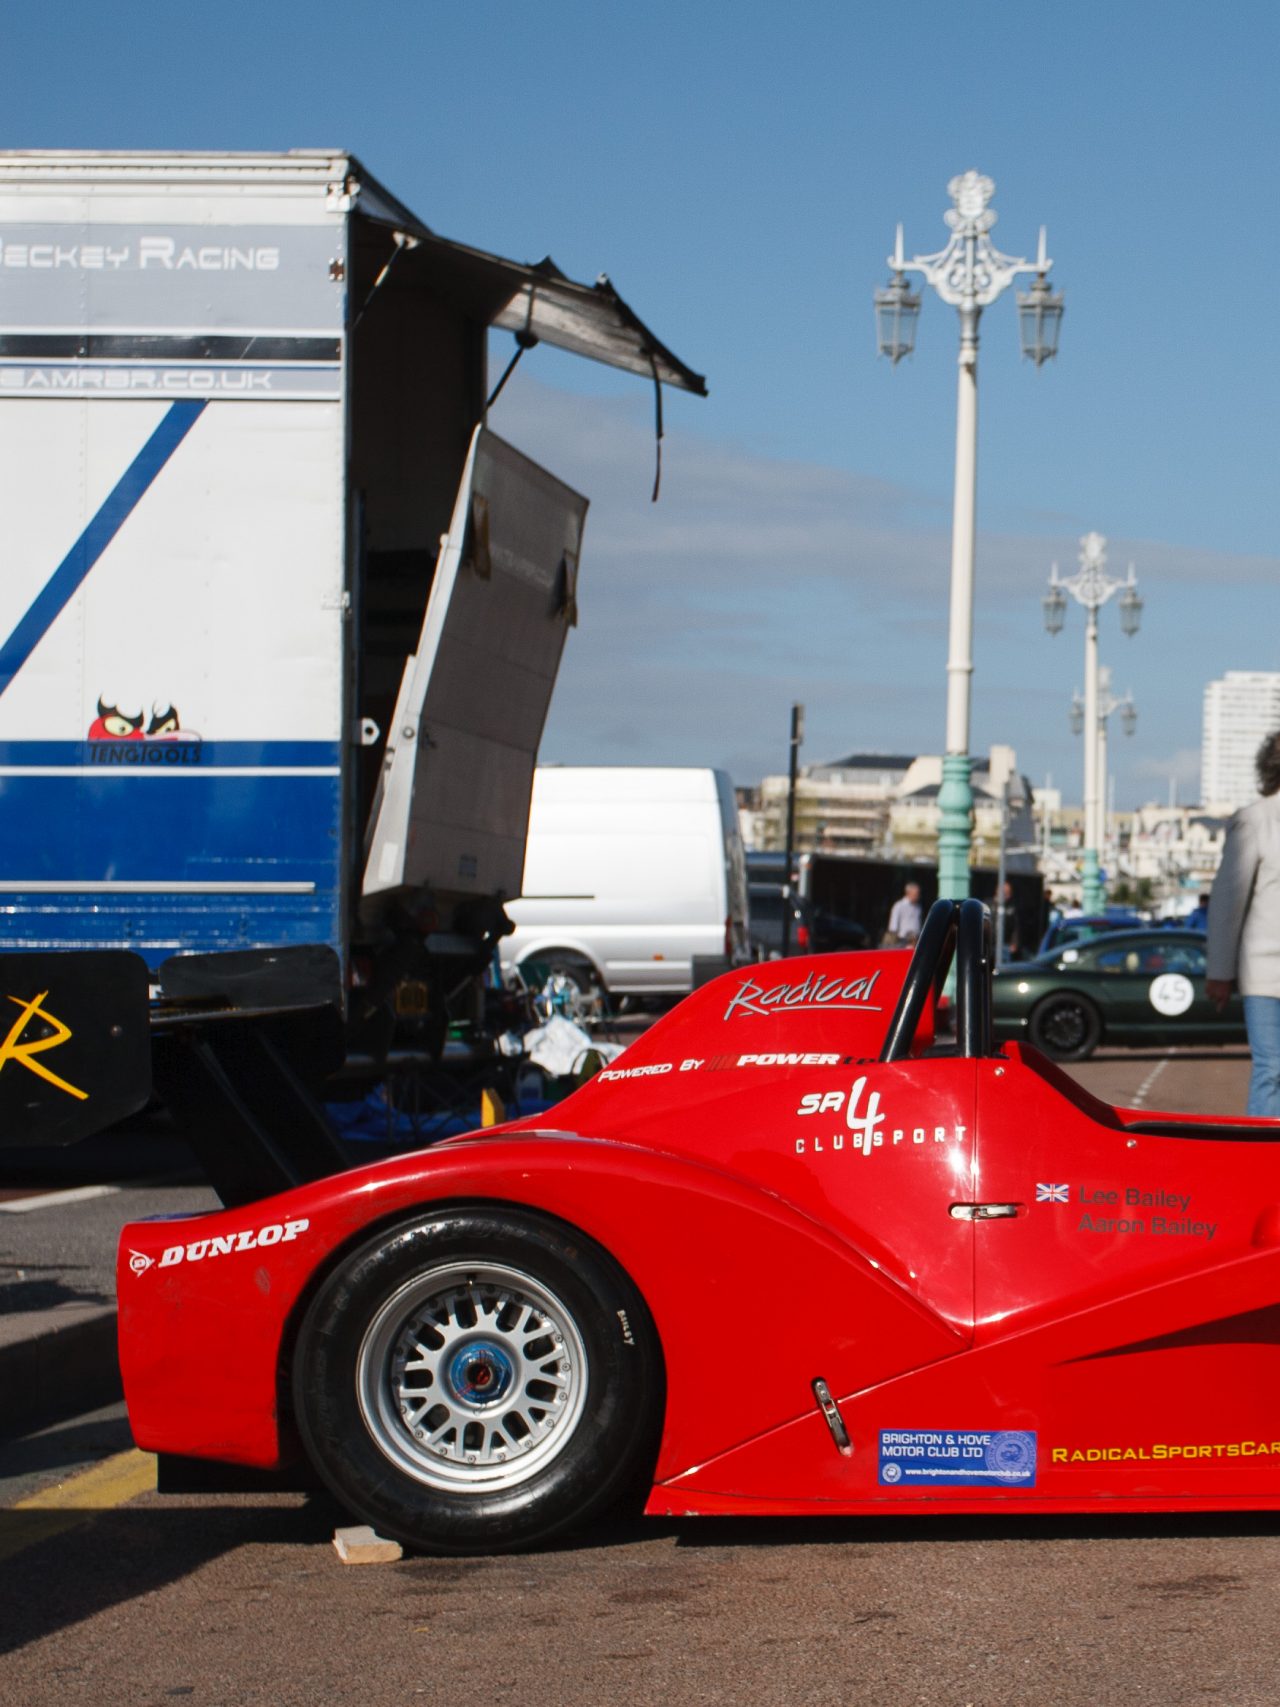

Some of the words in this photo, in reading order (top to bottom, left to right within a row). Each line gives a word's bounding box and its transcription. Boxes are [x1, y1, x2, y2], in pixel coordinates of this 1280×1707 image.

[0, 236, 130, 270] ECKEY
[723, 969, 882, 1021] Radical
[1158, 980, 1187, 1003] 45
[1079, 1186, 1119, 1205] Lee
[1125, 1188, 1191, 1213] Bailey
[1078, 1213, 1145, 1233] Aaron
[1151, 1216, 1218, 1241] Bailey
[158, 1218, 310, 1268] DUNLOP
[882, 1433, 942, 1444] BRIGHTON
[945, 1434, 955, 1445] &
[958, 1435, 991, 1446] HOVE
[882, 1446, 925, 1457] MOTOR
[928, 1447, 960, 1458] CLUB
[963, 1448, 984, 1458] LTD
